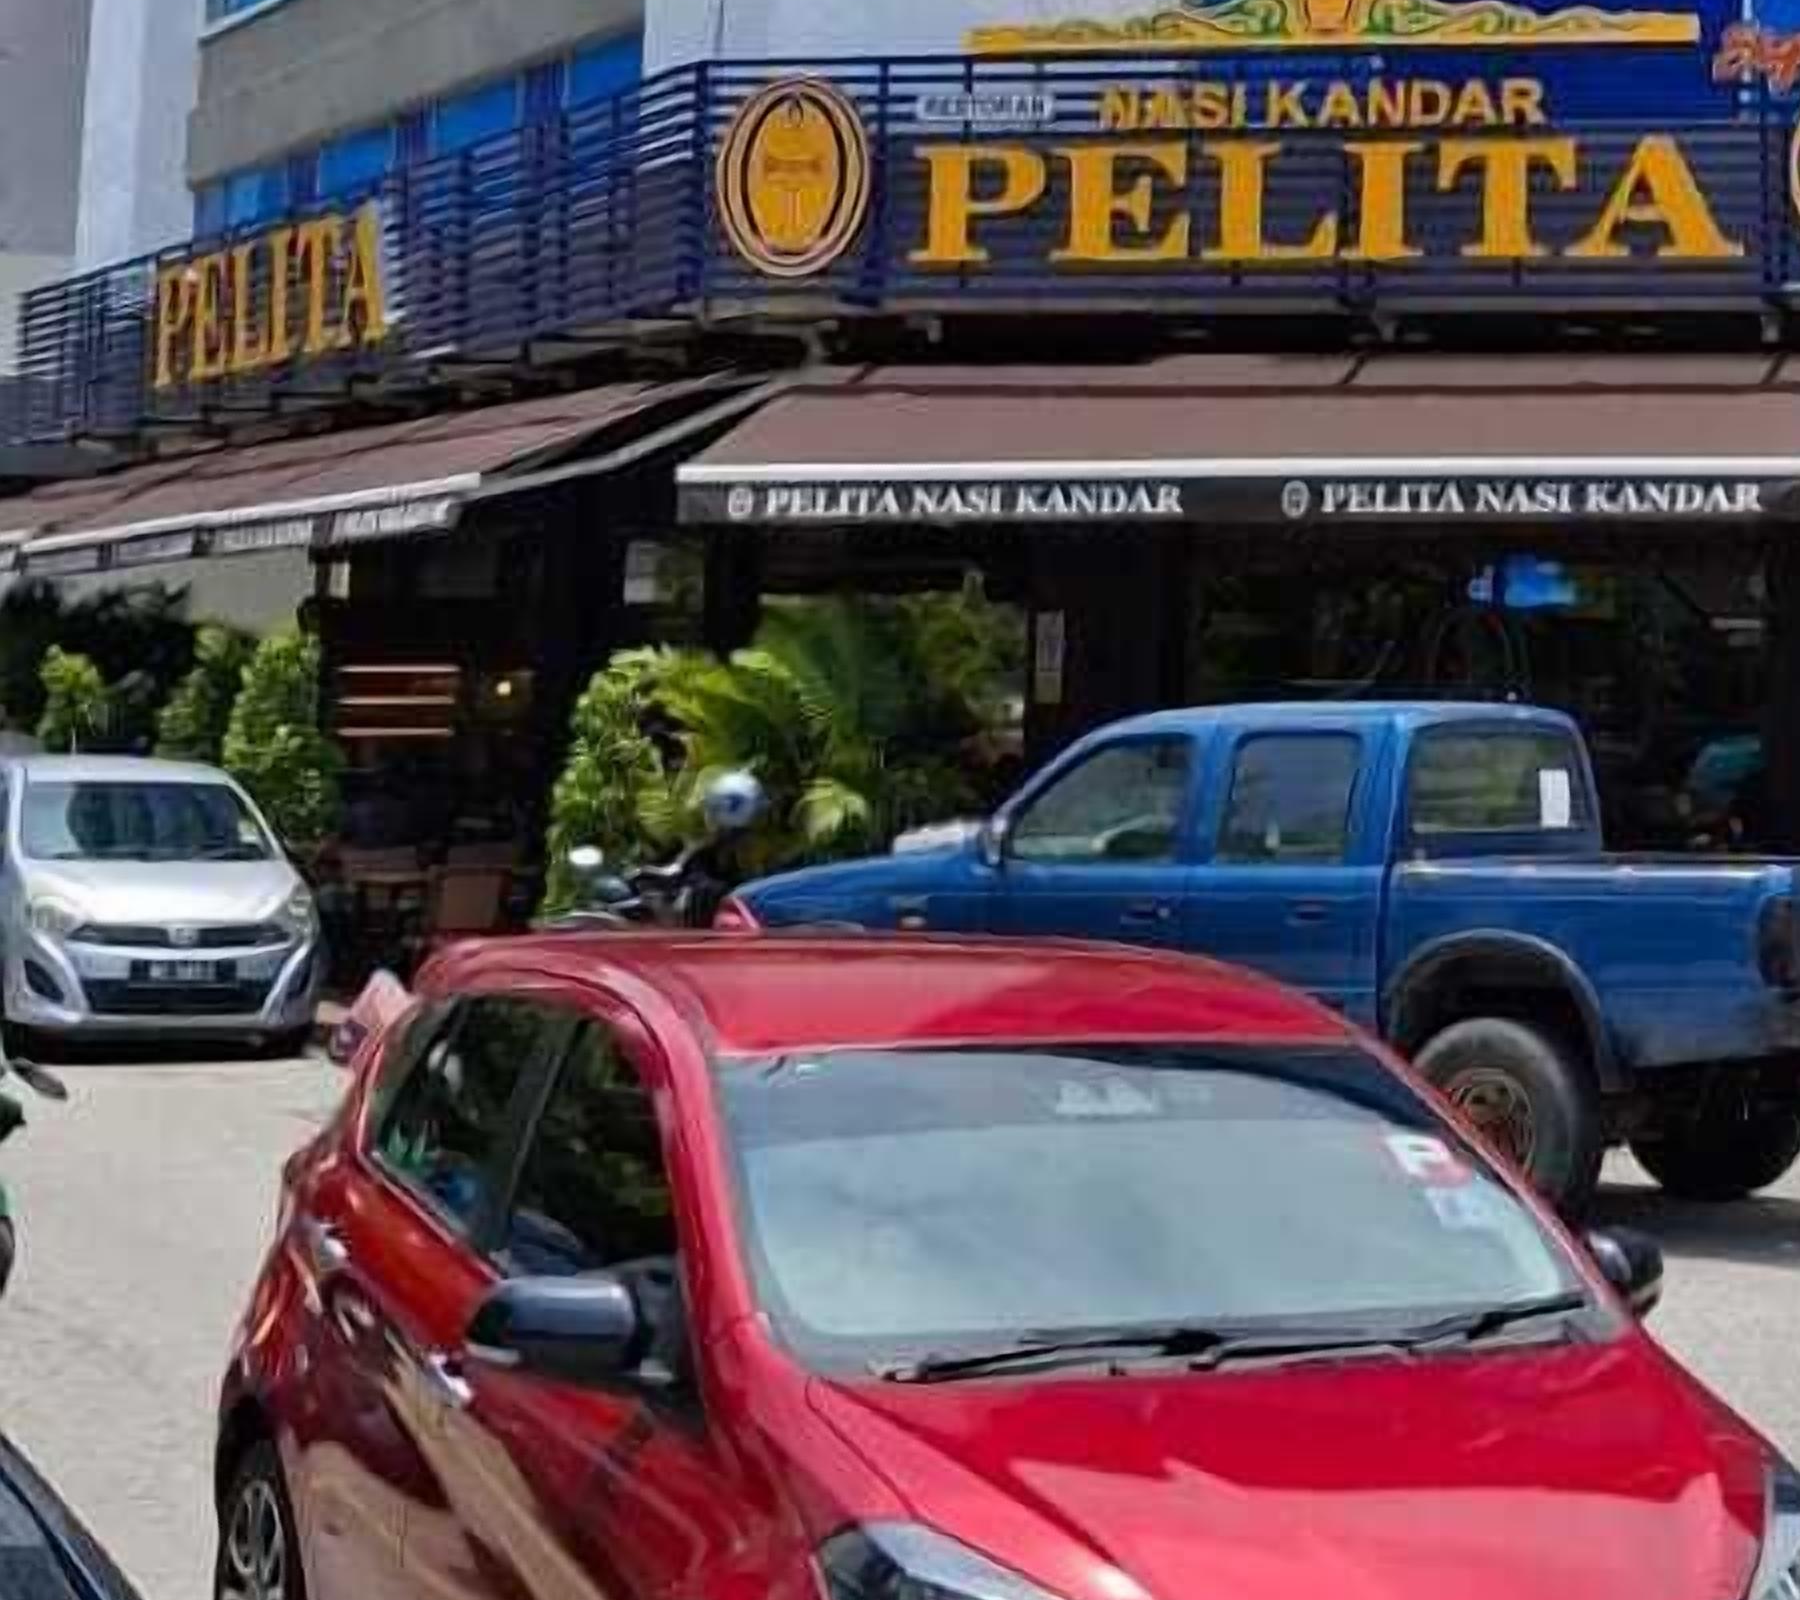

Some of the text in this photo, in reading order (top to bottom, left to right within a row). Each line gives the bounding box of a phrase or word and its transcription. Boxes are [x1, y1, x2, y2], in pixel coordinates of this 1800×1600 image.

[1102, 78, 1546, 129] NASI KANDAR
[908, 133, 1744, 263] PELITA
[156, 201, 387, 388] PELITA
[767, 485, 1184, 515] PELITA NASI KANDAR
[1320, 483, 1762, 513] PELITA NASI KANDAR
